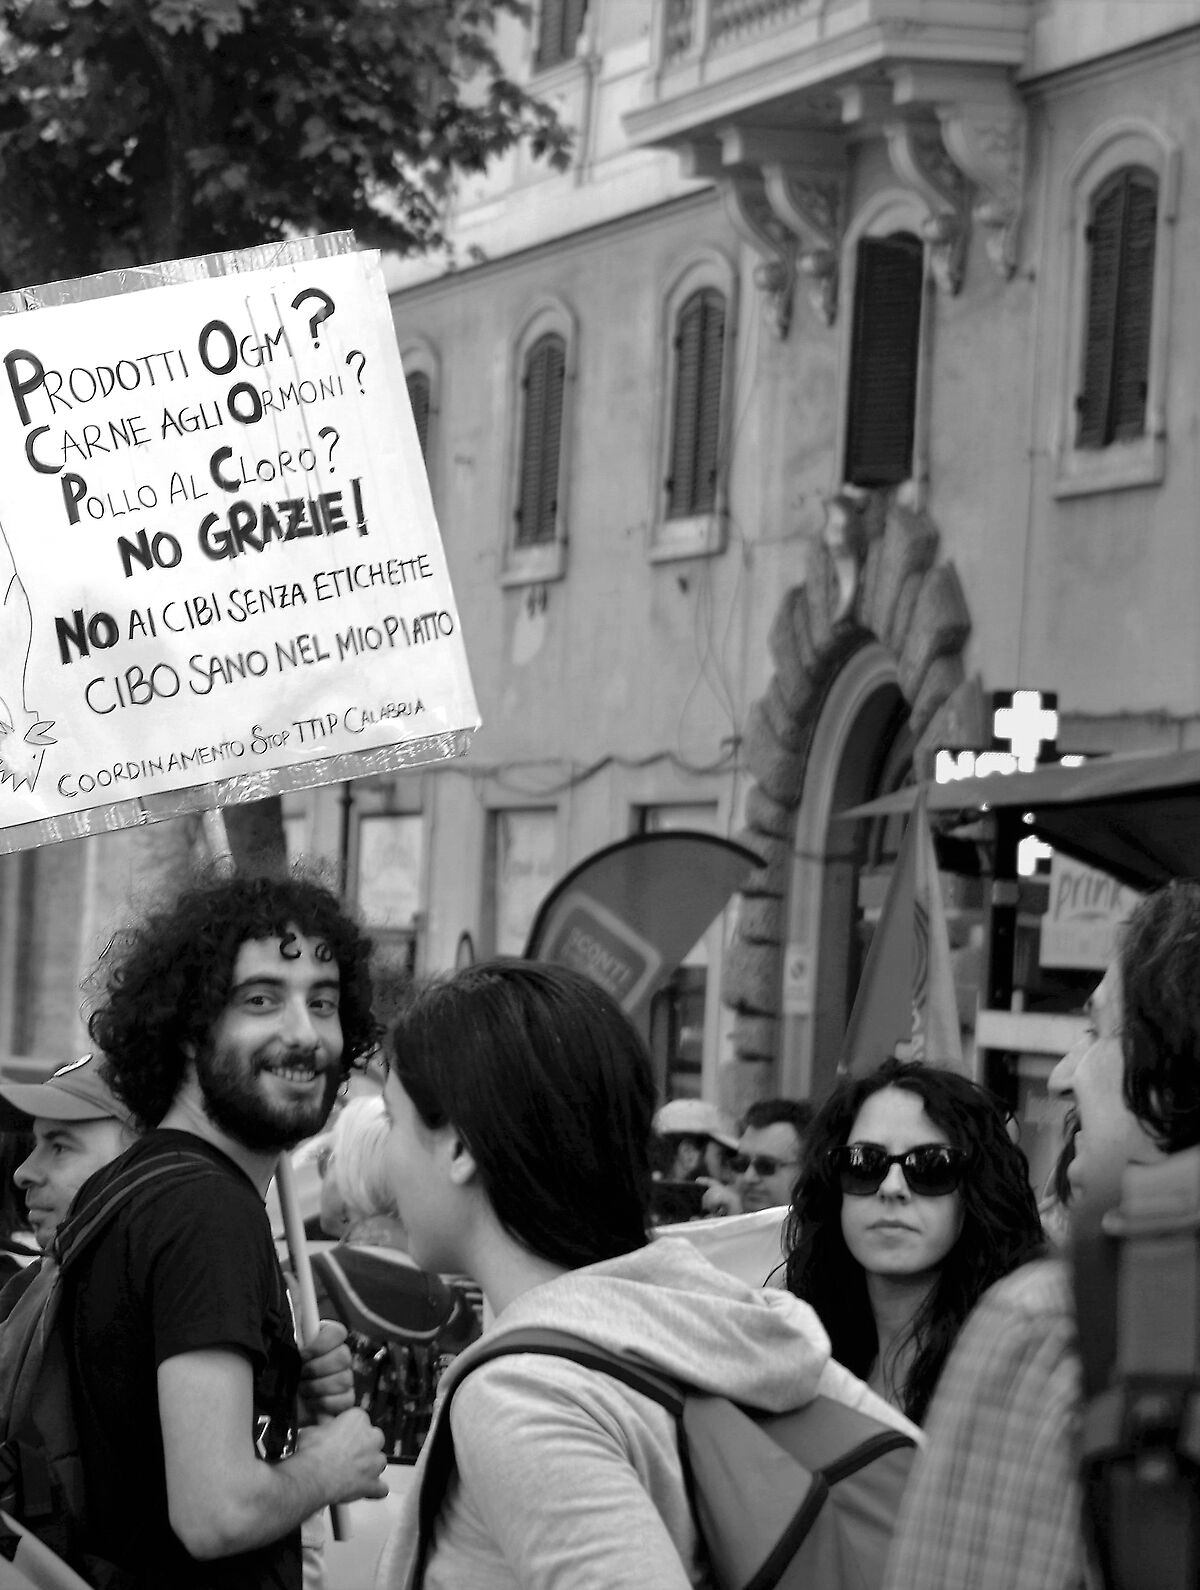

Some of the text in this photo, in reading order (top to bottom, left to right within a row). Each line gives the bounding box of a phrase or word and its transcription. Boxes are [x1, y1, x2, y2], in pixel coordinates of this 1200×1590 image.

[3, 348, 189, 427] PRODOTTI
[24, 414, 153, 474] CARNE
[160, 401, 223, 442] AGLI
[60, 471, 158, 526] POLLO
[170, 472, 208, 506] AL
[117, 527, 183, 578] NO
[54, 554, 434, 665] NO AI CIBI SENZA ETICHETTE
[84, 610, 455, 716] CIBO SANO NEL MIO PIATTO
[57, 698, 425, 798] COORDINAMENTO STOP TTIP CALABRIA
